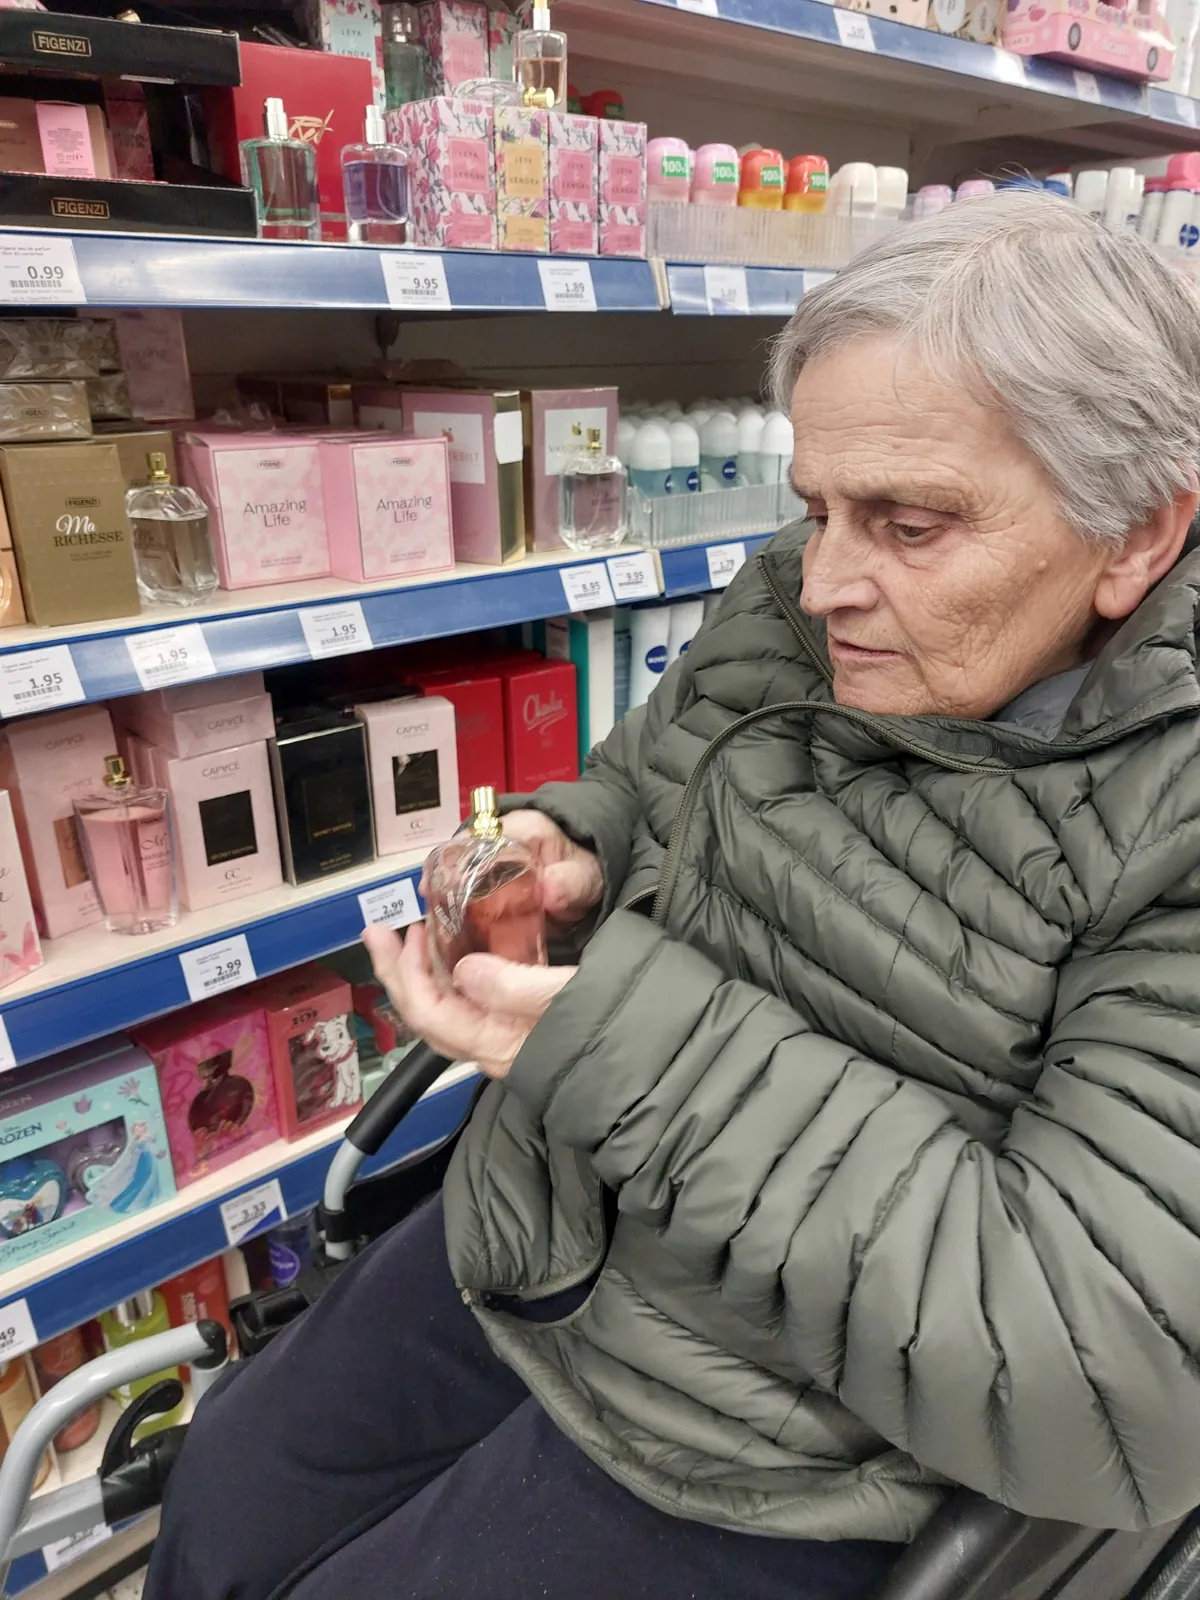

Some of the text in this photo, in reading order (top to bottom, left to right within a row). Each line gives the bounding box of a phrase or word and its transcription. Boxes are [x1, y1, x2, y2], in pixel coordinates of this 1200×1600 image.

[38, 36, 87, 52] FIGENZI
[57, 201, 105, 216] FIGENZI
[27, 265, 64, 280] 0.99
[413, 277, 439, 290] 9.95
[243, 500, 308, 516] Amazing
[376, 496, 433, 512] Amazing
[55, 513, 97, 535] Ma
[263, 514, 292, 528] Life
[394, 510, 419, 524] Life
[53, 531, 124, 548] RICHESSE
[331, 623, 357, 637] 1.95
[158, 647, 188, 665] 1.95
[29, 672, 63, 690] 1.95
[382, 899, 405, 916] 2.99
[215, 958, 242, 977] 2.99
